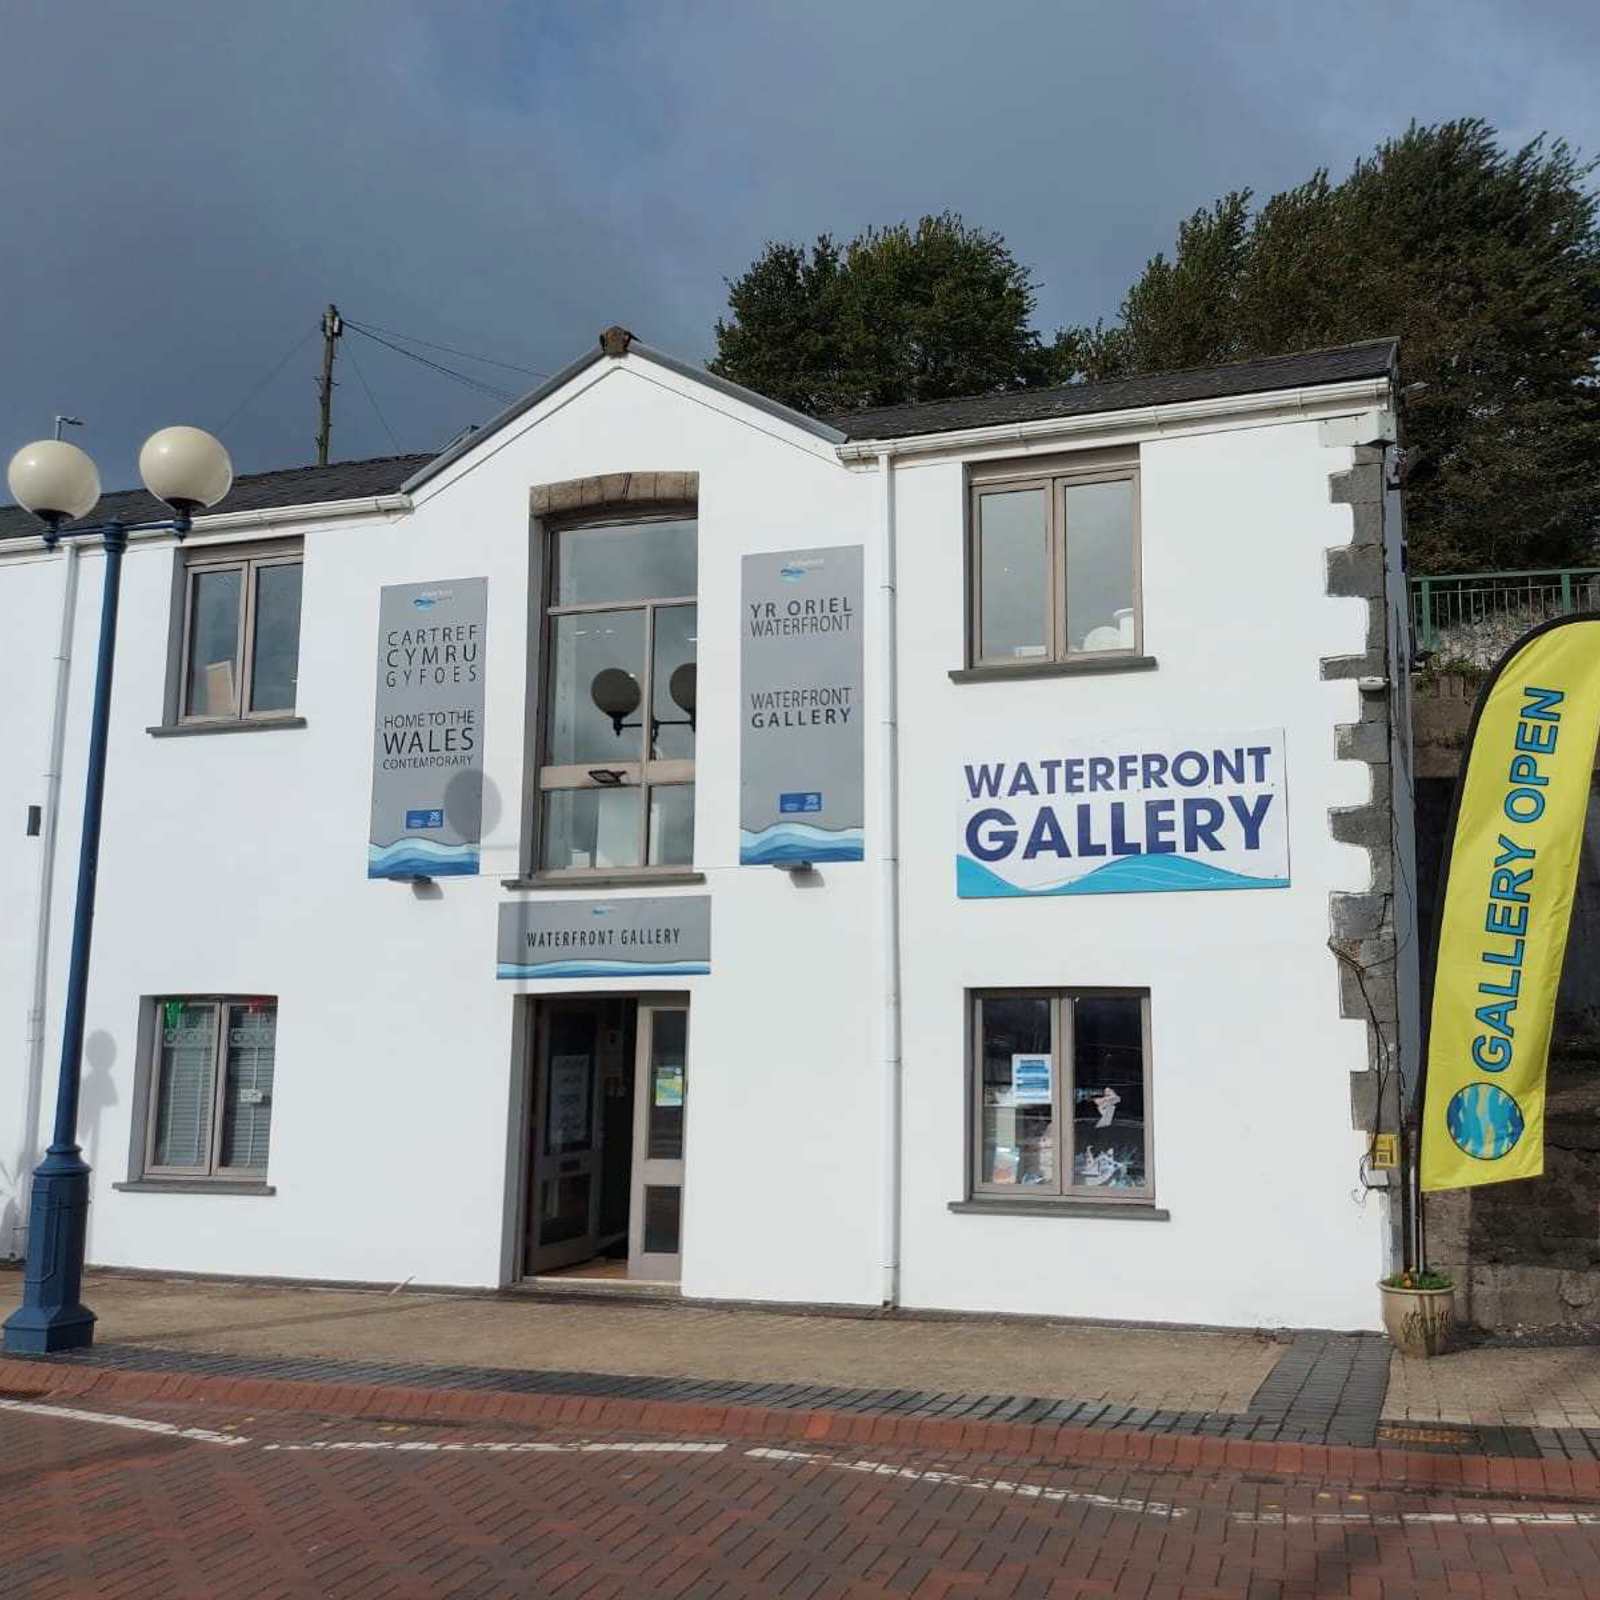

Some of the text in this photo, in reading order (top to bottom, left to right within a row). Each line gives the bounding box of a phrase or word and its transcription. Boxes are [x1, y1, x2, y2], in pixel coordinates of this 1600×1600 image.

[750, 597, 852, 619] YR ORIEL
[387, 624, 478, 647] CARTREF
[750, 613, 852, 638] WATERFRONT
[386, 643, 477, 668] CYMRU
[386, 664, 477, 688] GYFOES
[750, 687, 852, 710] WATERFRONT
[384, 710, 475, 729] HOME TO THE
[751, 707, 852, 729] GALLERY
[383, 727, 474, 755] WALES
[383, 754, 474, 770] CONTEMPORARY
[964, 746, 1271, 799] WATERFRONT
[965, 794, 1274, 862] GALLERY
[1471, 686, 1565, 1074] GALLERY OPEN
[526, 928, 681, 948] WATERFRONT GALLERY
